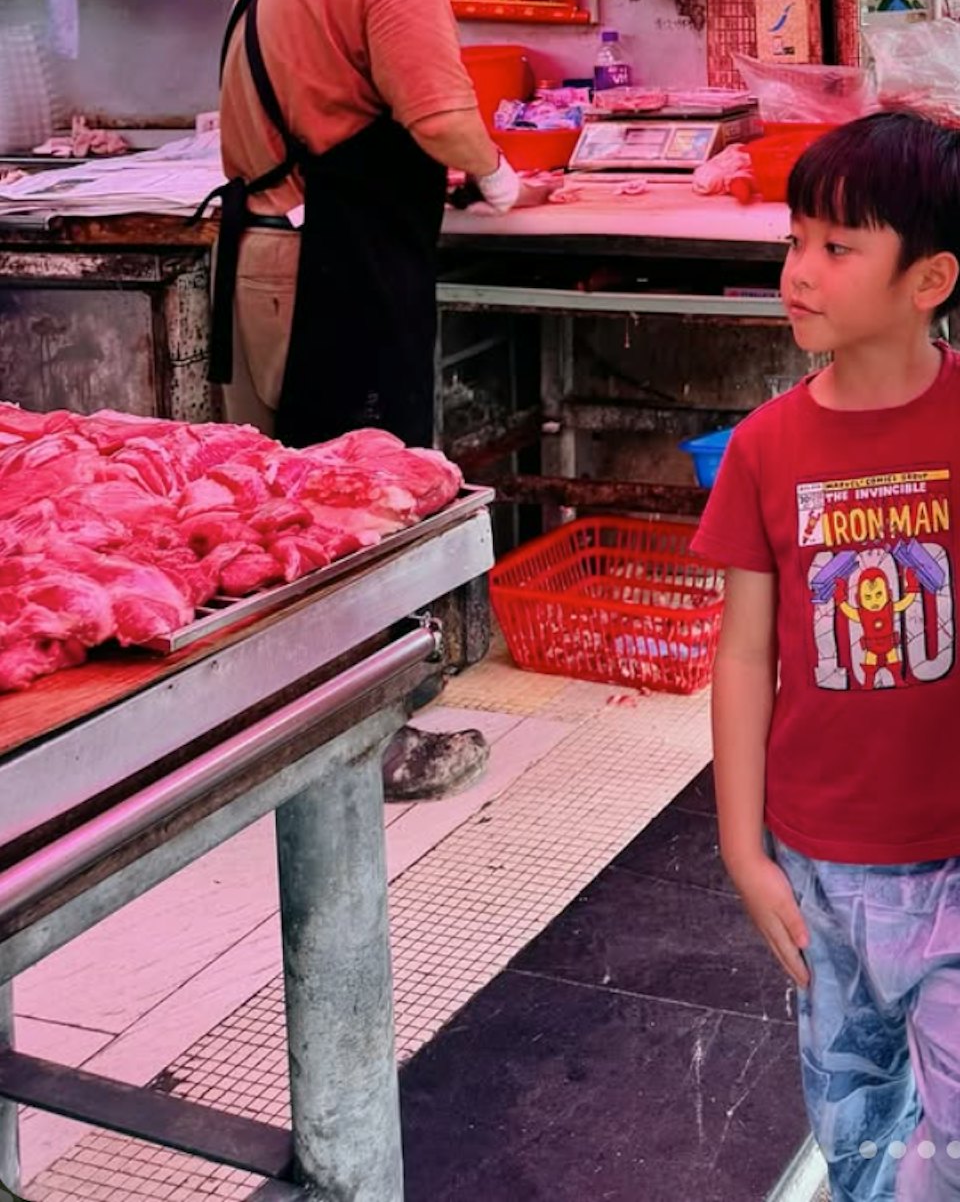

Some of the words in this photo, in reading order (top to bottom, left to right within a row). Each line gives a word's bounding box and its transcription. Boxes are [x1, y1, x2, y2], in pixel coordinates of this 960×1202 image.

[826, 490, 849, 503] THE
[855, 482, 927, 499] INVINCIBLE
[822, 507, 885, 547] IRON
[889, 498, 950, 539] MAN
